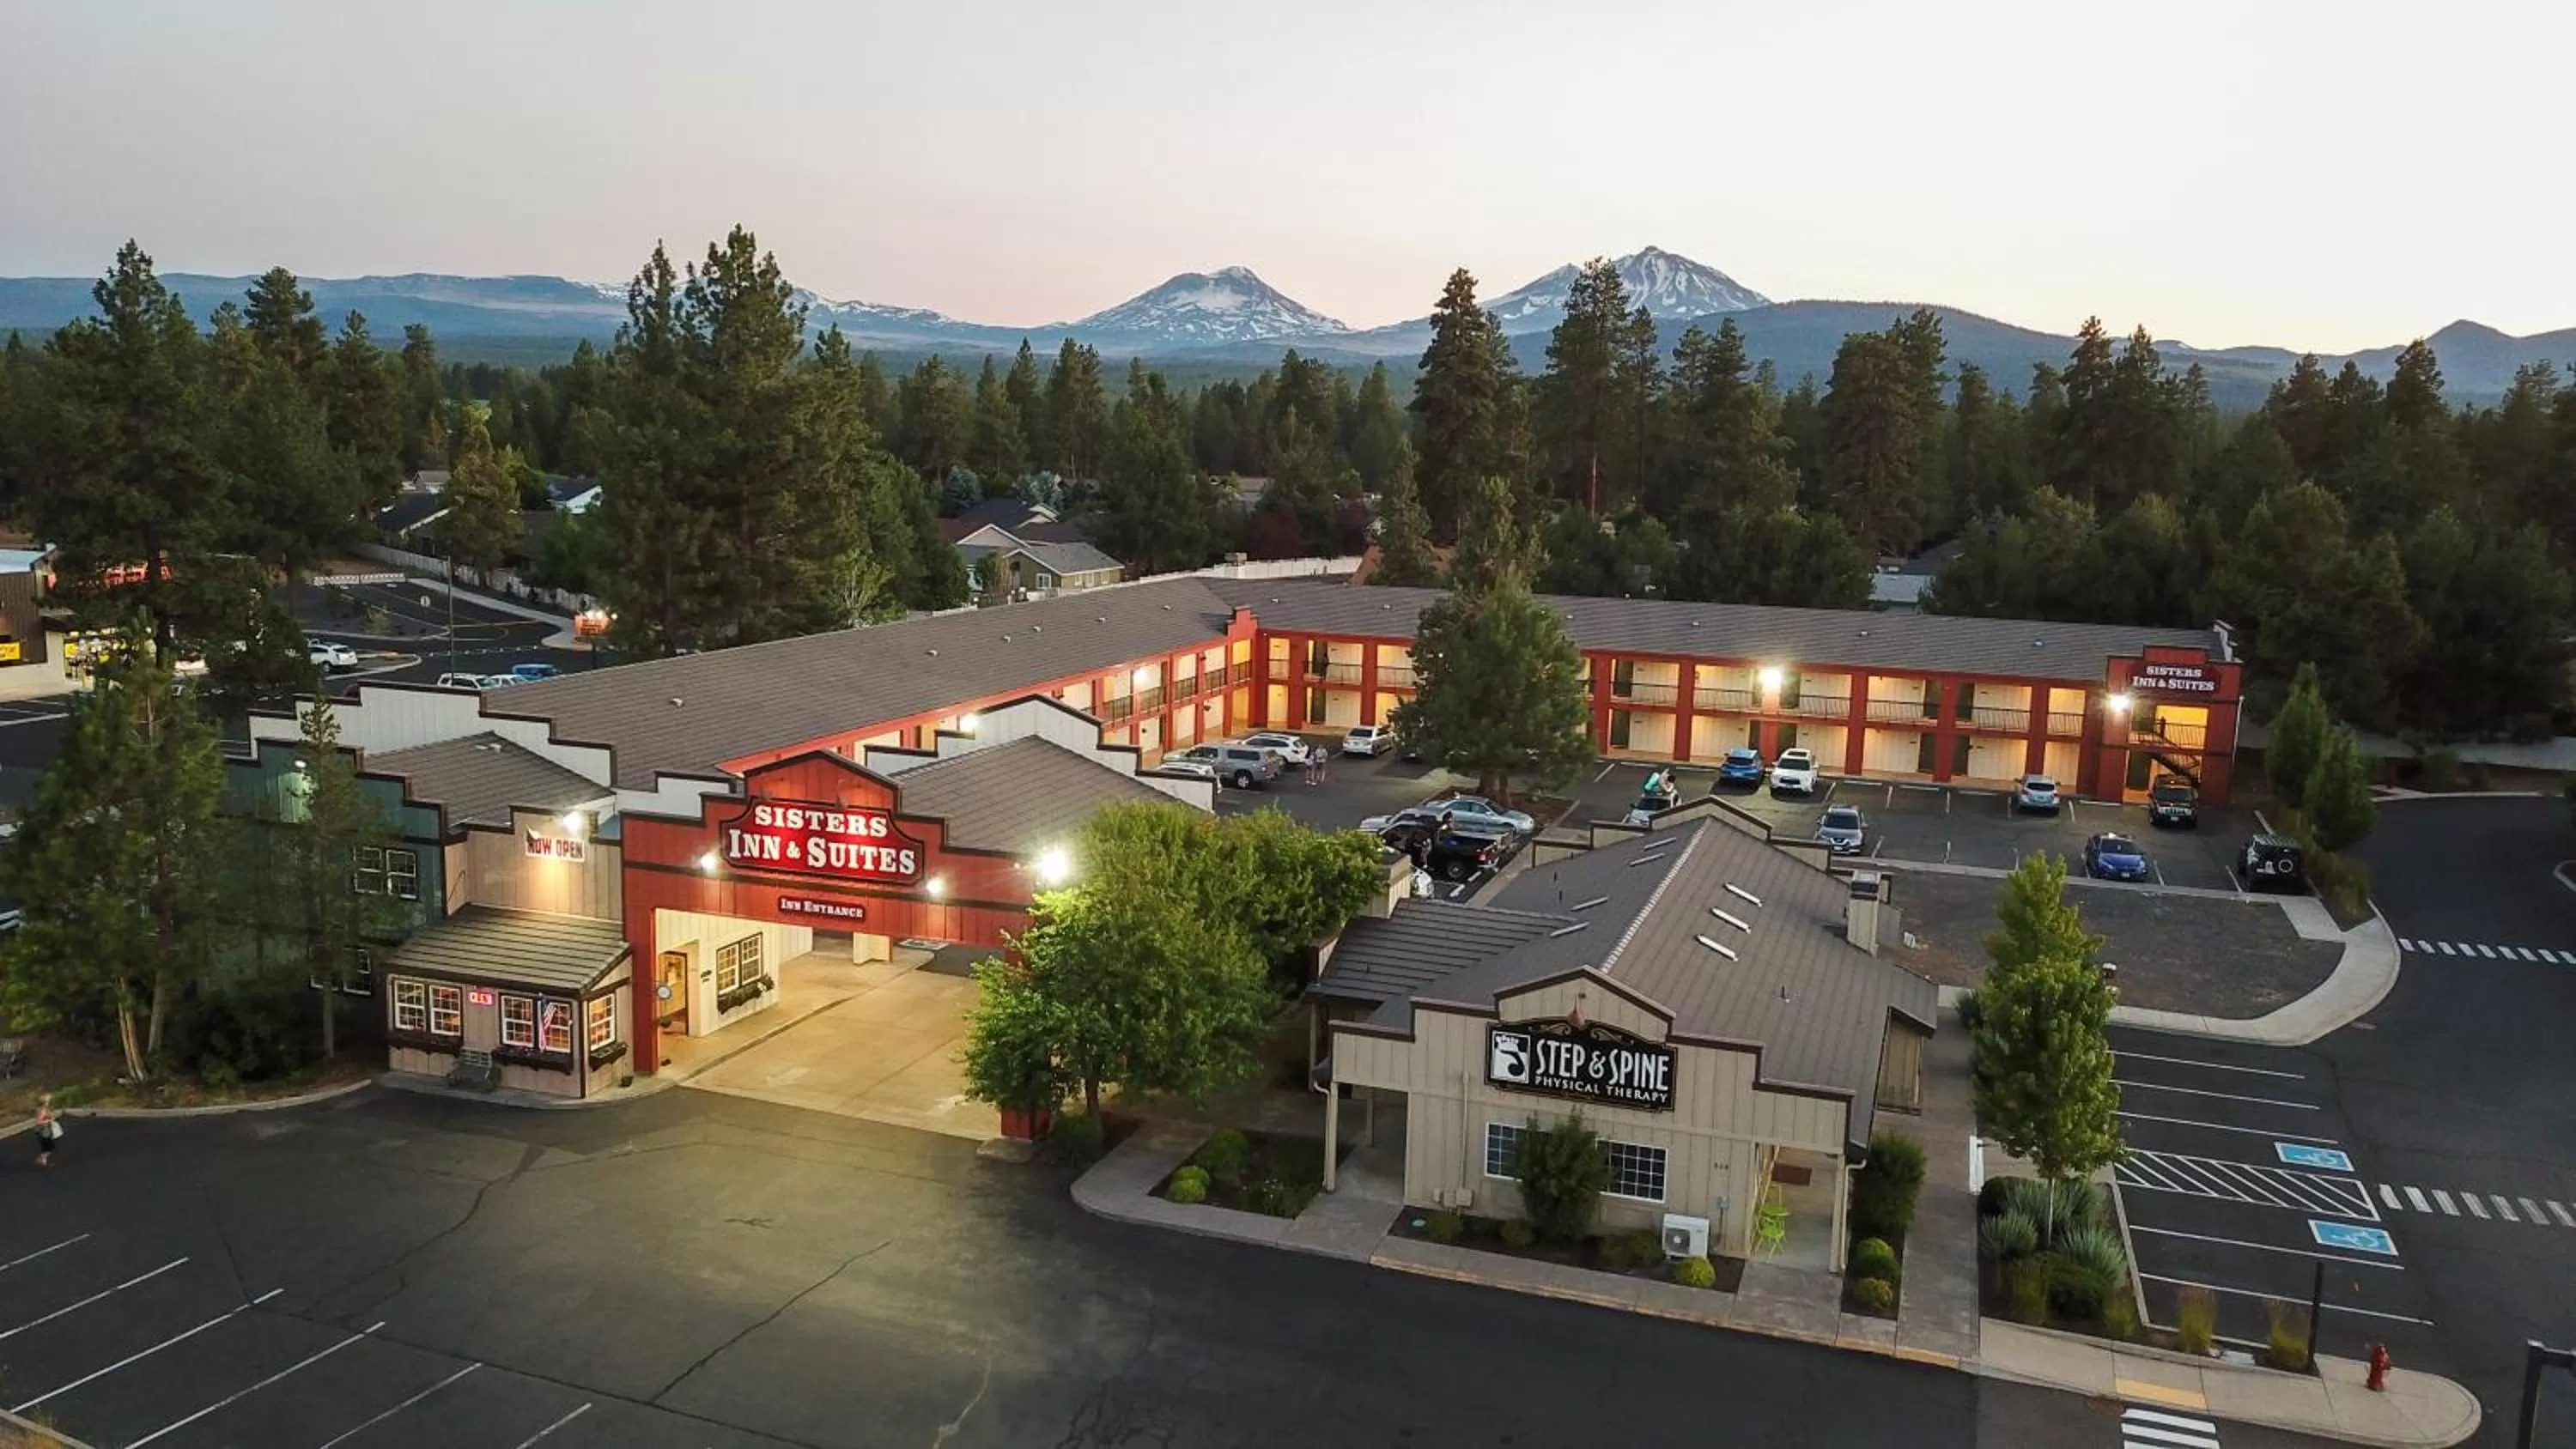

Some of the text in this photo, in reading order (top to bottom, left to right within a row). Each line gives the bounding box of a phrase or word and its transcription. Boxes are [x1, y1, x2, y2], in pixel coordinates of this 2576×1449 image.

[2146, 666, 2202, 677] SISTERS
[2133, 676, 2156, 688] INN
[2168, 679, 2215, 691] SUITES
[754, 805, 888, 838] SISTERS
[556, 840, 583, 858] OPEN
[729, 829, 915, 875] INN & SUITES
[781, 898, 864, 918] INN ENTRANCE
[1535, 1039, 1670, 1090] STEP & SPINE
[1534, 1076, 1668, 1103] PHYSICAL THERAPY
